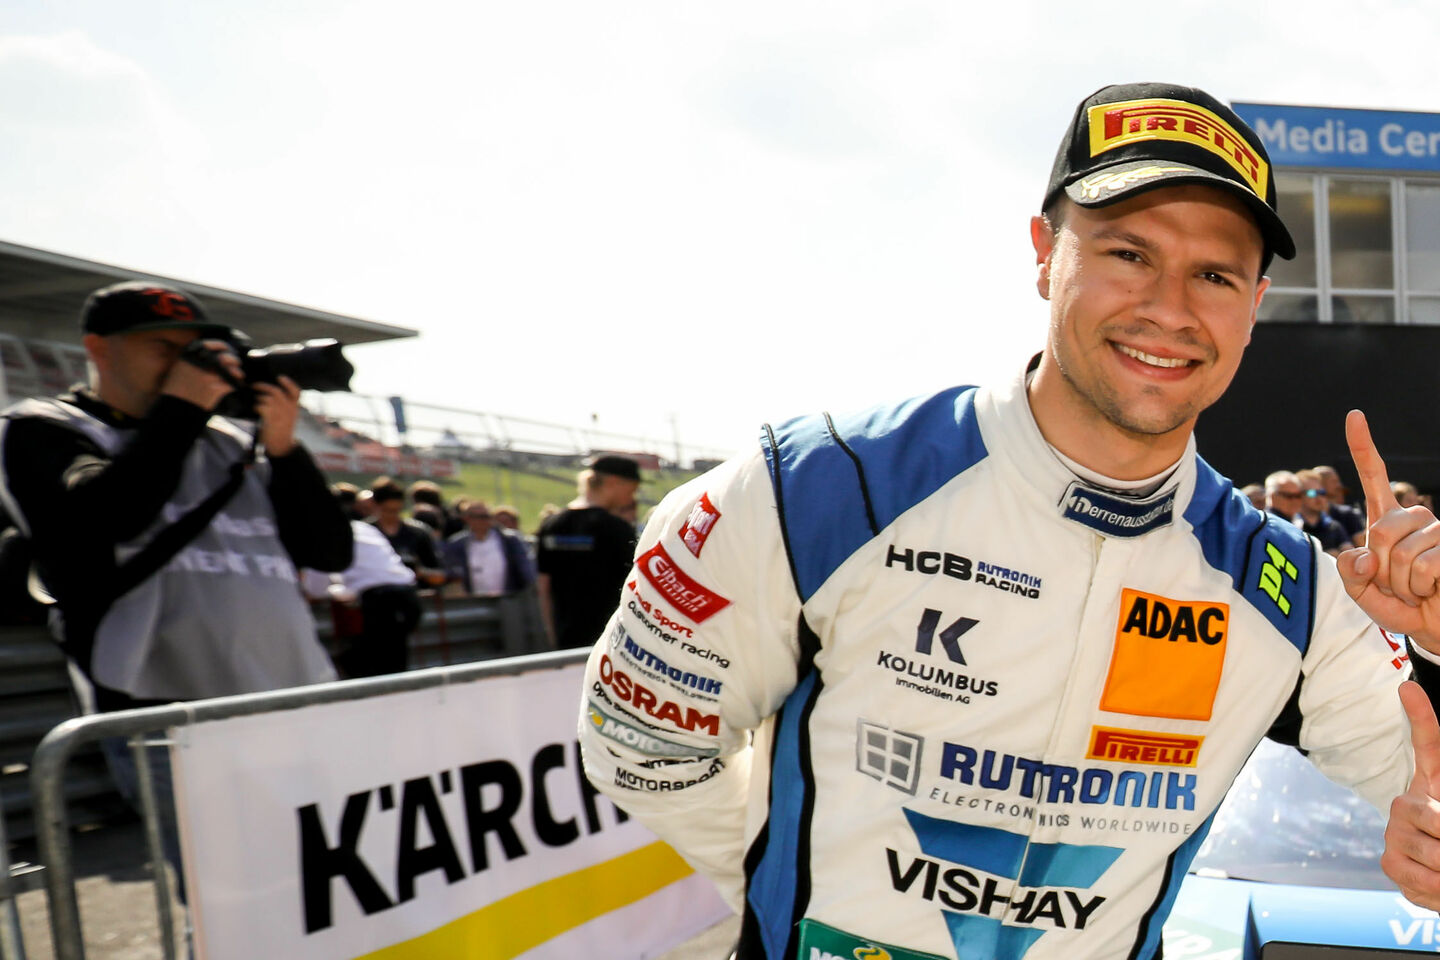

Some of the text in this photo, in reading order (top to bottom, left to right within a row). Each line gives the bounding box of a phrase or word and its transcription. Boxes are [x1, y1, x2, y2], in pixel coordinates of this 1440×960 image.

[1104, 104, 1259, 184] PIRELLI
[1255, 118, 1368, 154] Media
[886, 544, 1042, 588] HCB RUTRONIK
[975, 574, 1040, 599] RACING
[653, 608, 694, 638] Sport
[1122, 596, 1225, 645] ADAC
[681, 641, 730, 669] racing
[877, 650, 998, 696] KOLUMBUS
[600, 654, 720, 736] OSRAM
[955, 694, 970, 704] AG
[1092, 730, 1200, 765] PIRELLI
[940, 742, 1198, 811] RUTRONIK
[297, 741, 632, 936] KÄRC
[1081, 816, 1192, 835] WORLDWIDE
[886, 847, 1106, 930] VISHAY
